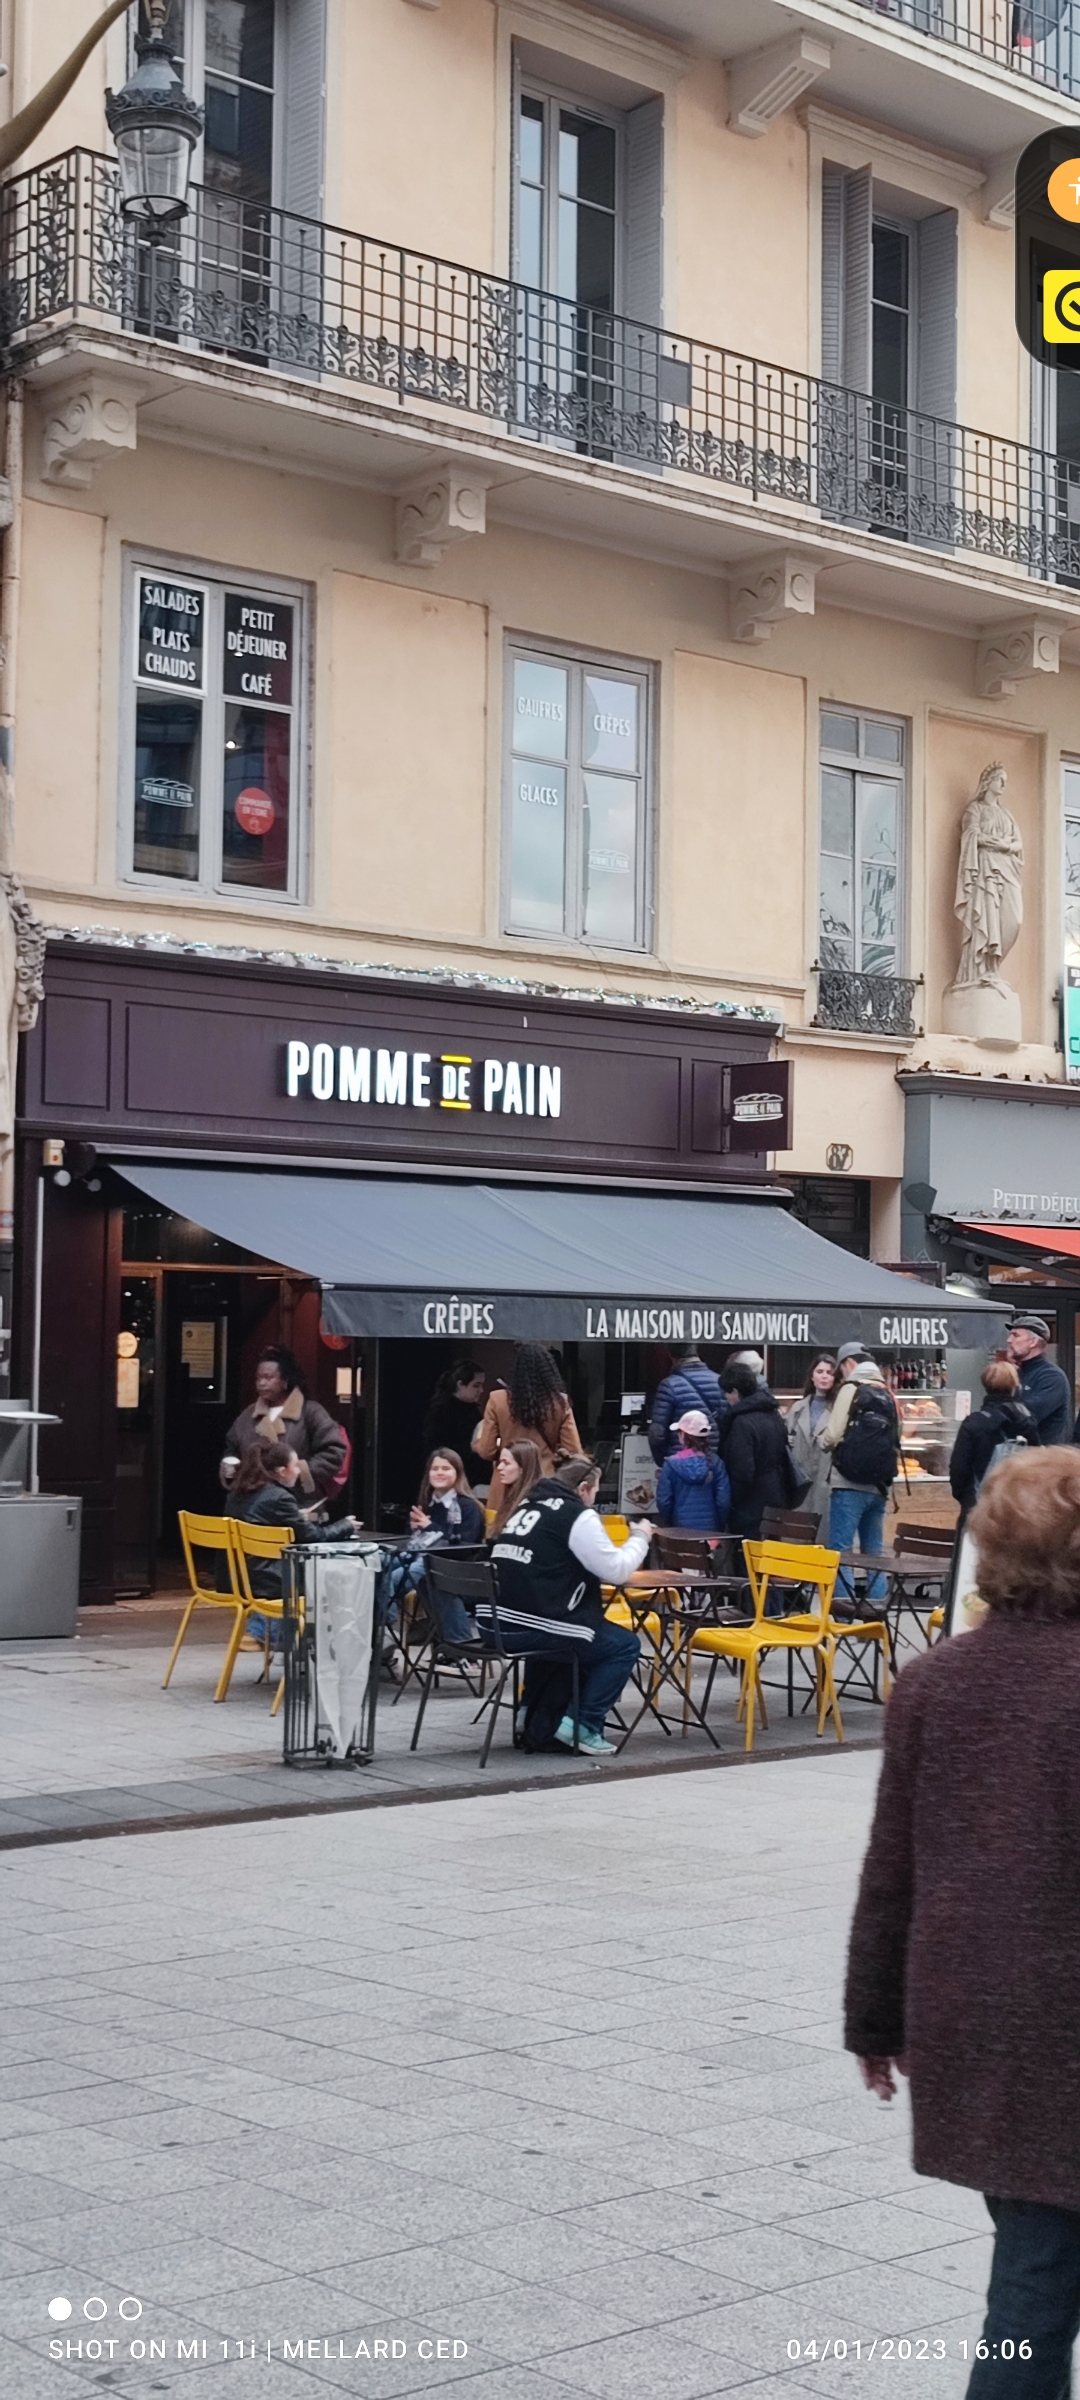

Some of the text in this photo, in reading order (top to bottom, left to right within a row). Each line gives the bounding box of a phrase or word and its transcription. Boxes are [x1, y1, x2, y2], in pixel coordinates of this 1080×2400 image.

[144, 586, 200, 615] SALADES
[241, 607, 275, 632] PETIT
[152, 626, 190, 653] PLATS
[227, 629, 287, 662] DÉJEUNER
[145, 653, 196, 681] CHAUDS
[241, 672, 272, 697] CAFÉ
[518, 697, 563, 721] GAUFRES
[520, 783, 558, 806] GLACES
[286, 1041, 561, 1118] POMME DE PAIN
[829, 1144, 850, 1170] 87
[423, 1295, 495, 1335] CRÊPES
[586, 1308, 809, 1342] LA MAISON DU SANDWICH
[879, 1317, 949, 1346] GAUFRES
